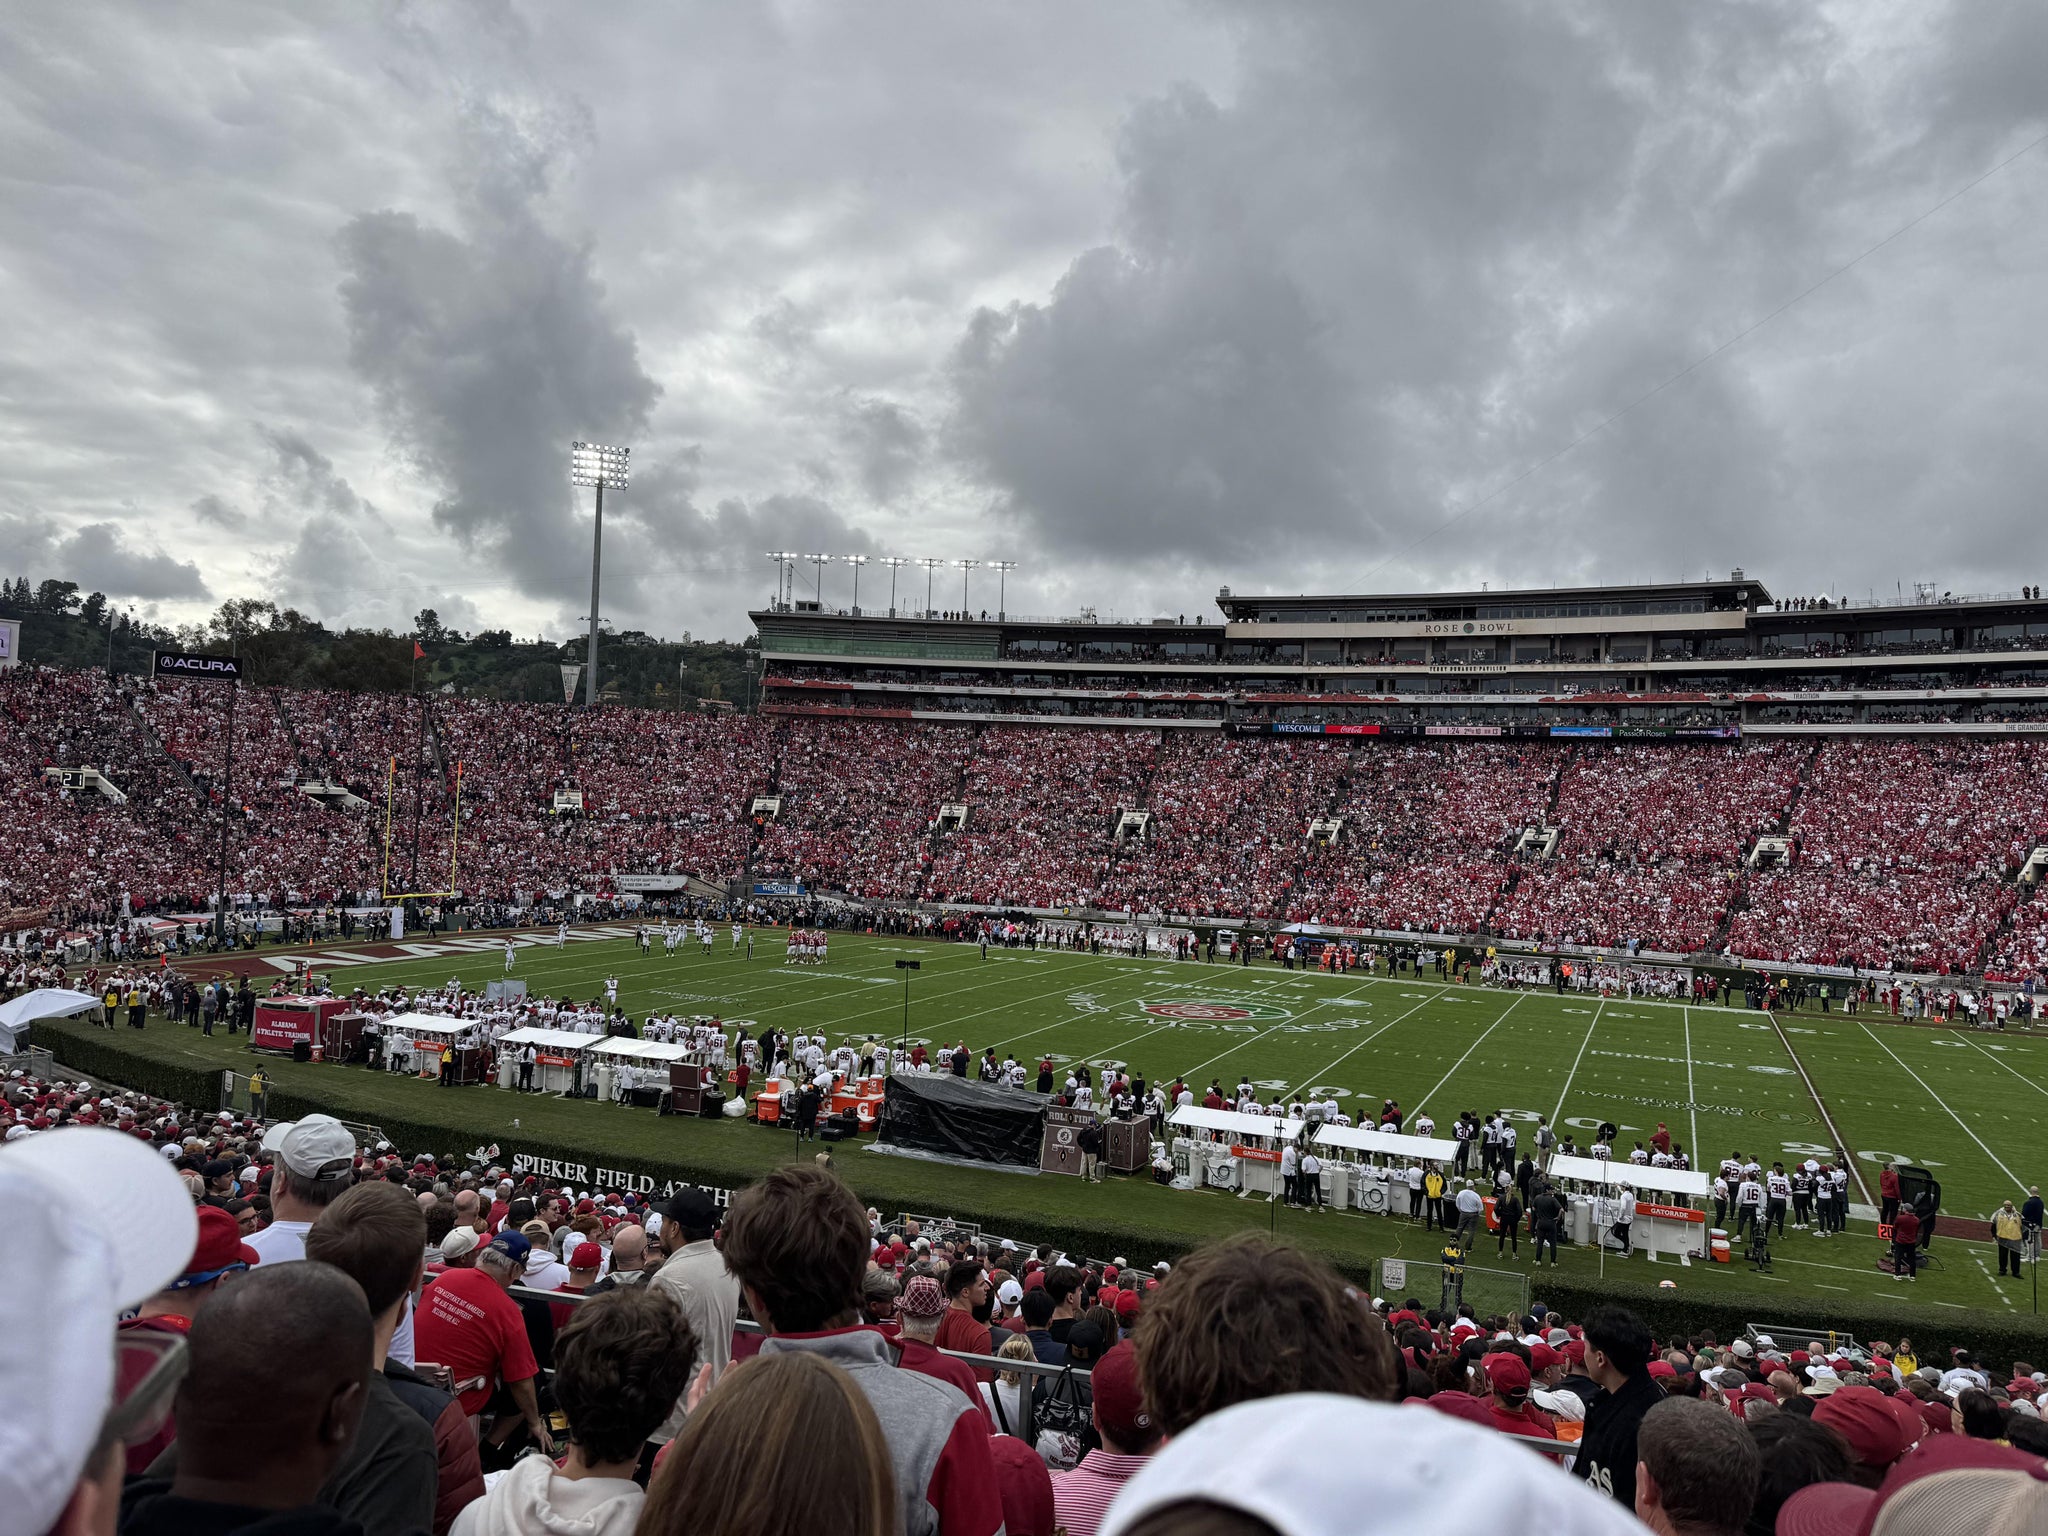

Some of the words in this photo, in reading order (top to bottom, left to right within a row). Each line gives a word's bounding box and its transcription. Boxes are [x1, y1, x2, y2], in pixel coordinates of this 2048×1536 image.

[1425, 624, 1458, 633] ROSE
[1480, 623, 1514, 632] BOWL
[173, 658, 238, 673] ACURA
[1278, 725, 1312, 733] WESCOM
[62, 773, 82, 787] 21
[271, 1020, 297, 1030] ALABAMA
[1115, 1012, 1258, 1033] BOWL
[1280, 1017, 1373, 1033] ROSE
[256, 1028, 284, 1038] ATHLETIC
[284, 1030, 311, 1040] TRAINING
[713, 1038, 723, 1048] 61
[797, 1041, 807, 1050] 24
[941, 1053, 952, 1063] 12
[1014, 1072, 1025, 1081] 49
[857, 1103, 869, 1117] G
[1145, 1101, 1158, 1111] 54
[1420, 1125, 1433, 1135] 87
[1457, 1126, 1470, 1138] 30
[1242, 1150, 1274, 1160] GATORADE
[1672, 1159, 1686, 1170] 98
[513, 1153, 589, 1184] SPIEKER
[595, 1167, 655, 1194] FIELD
[697, 1184, 737, 1208] TH
[1746, 1188, 1759, 1200] 16
[1771, 1183, 1786, 1195] 38
[1650, 1207, 1690, 1219] GATORADE
[1880, 1226, 1894, 1238] 20
